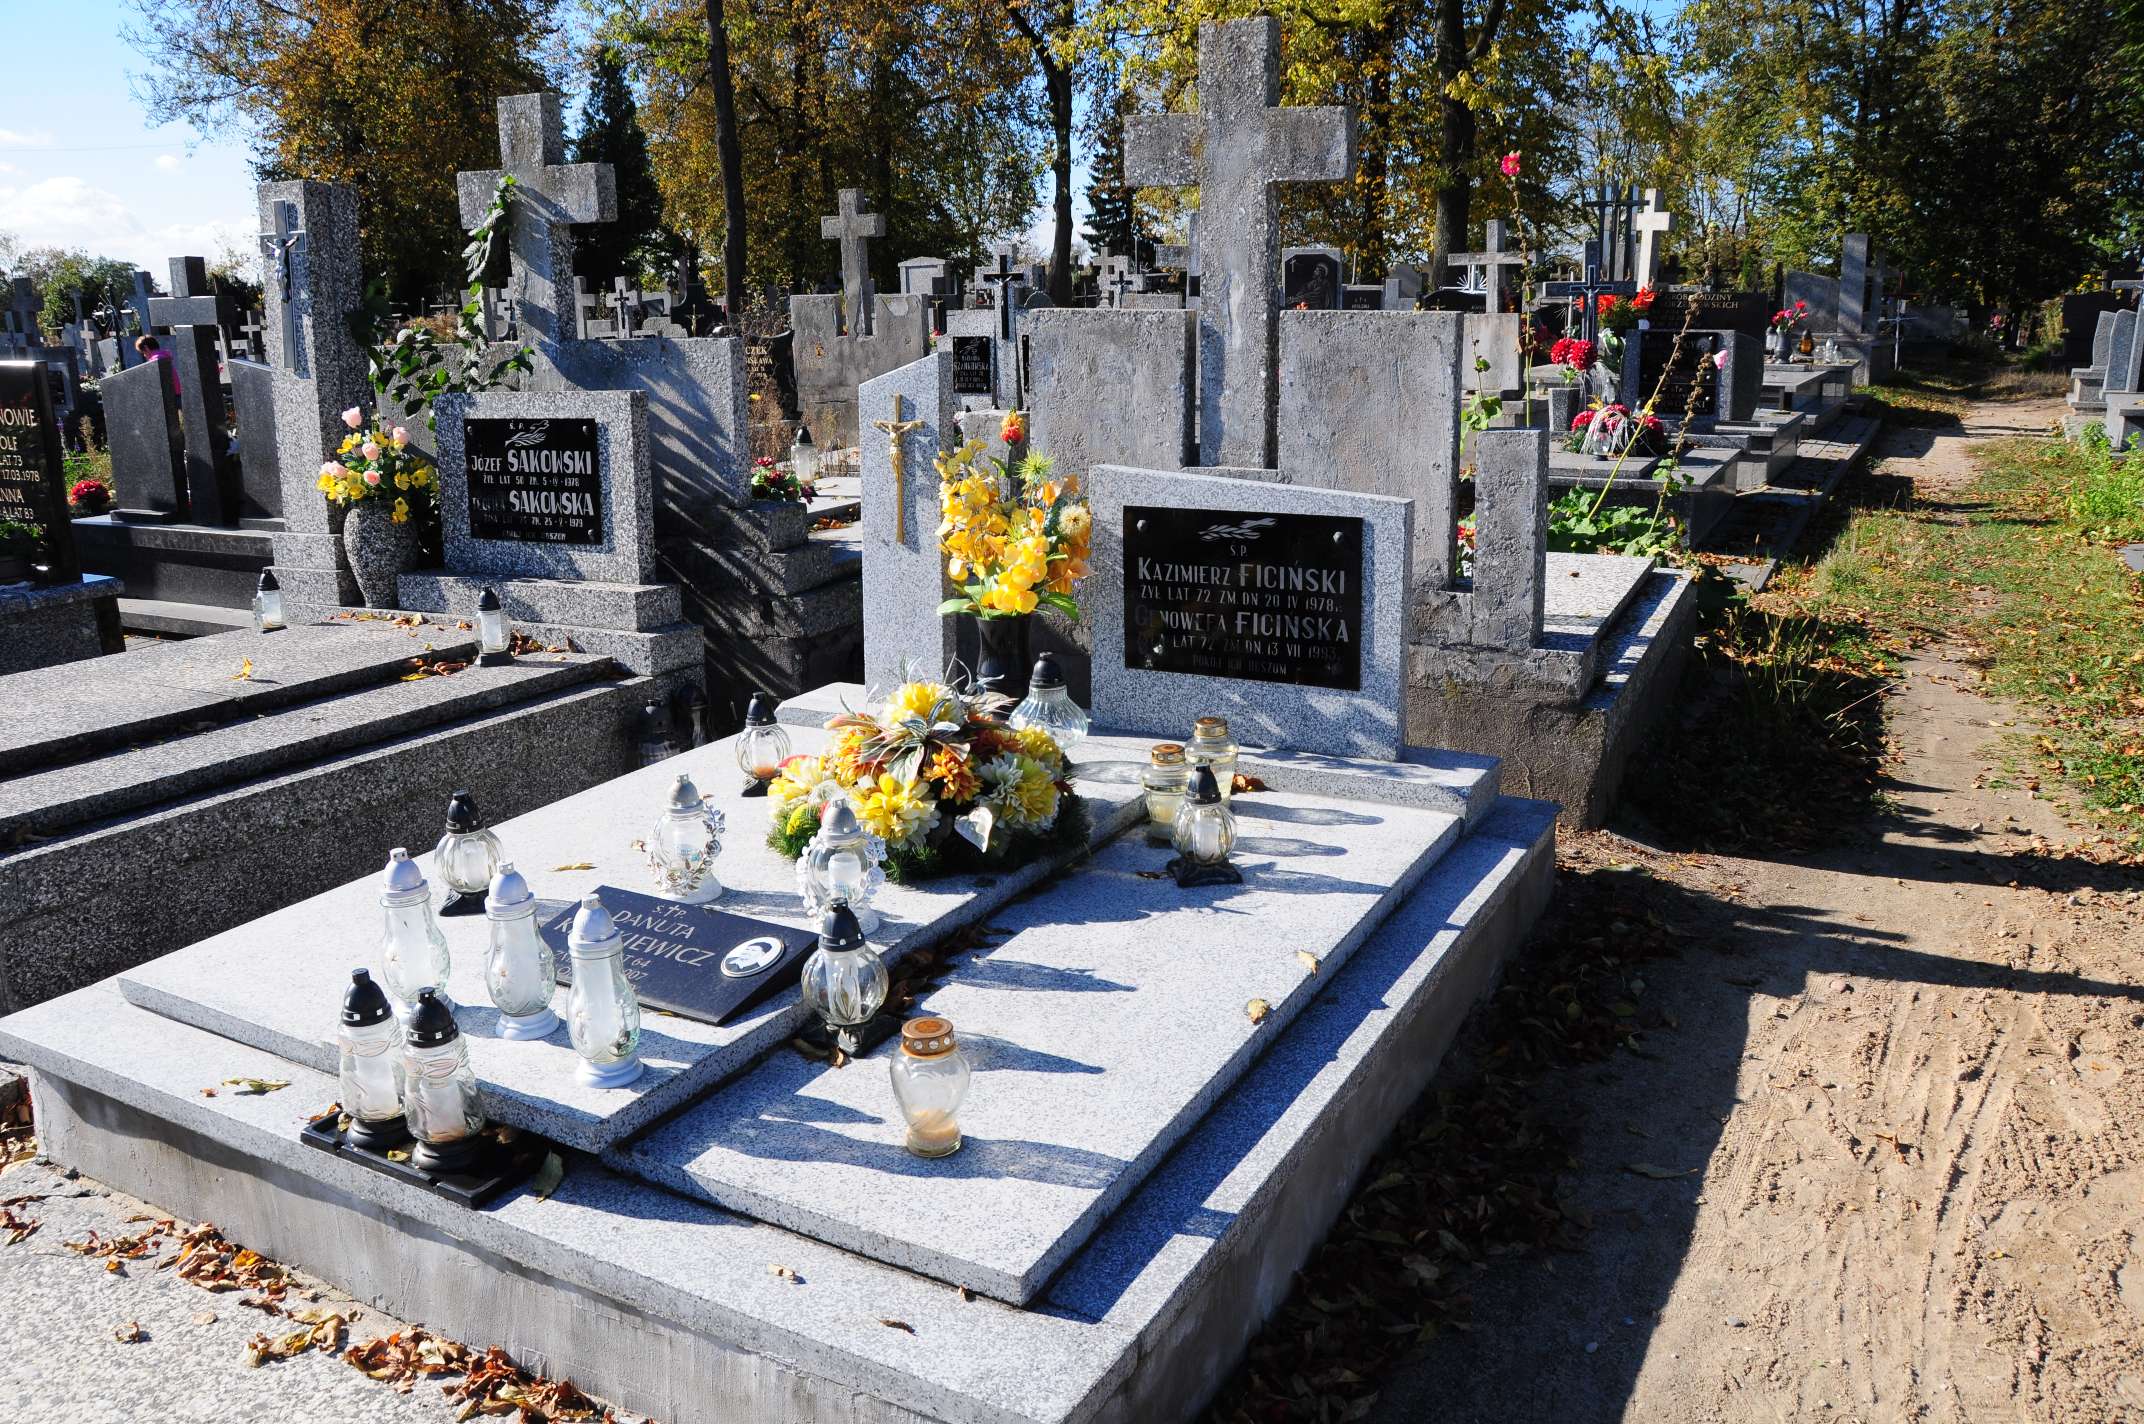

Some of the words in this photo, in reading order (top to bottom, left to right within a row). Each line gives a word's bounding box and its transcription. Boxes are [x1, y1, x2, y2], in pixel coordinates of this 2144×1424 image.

[13, 454, 23, 466] 73
[471, 454, 502, 472] JÓZEF
[507, 449, 592, 475] SAKOWSKI
[500, 475, 511, 485] LAT
[509, 490, 594, 516] SAKOWSKA
[1138, 556, 1231, 586] KAZIMIERZ
[1238, 559, 1345, 594] FICIŃSKI
[1168, 586, 1190, 601] LAT
[1196, 588, 1212, 604] 72
[1265, 594, 1280, 608] 20
[1287, 595, 1298, 609] IV
[1173, 635, 1197, 649] LAT
[612, 910, 696, 939] DANUTA
